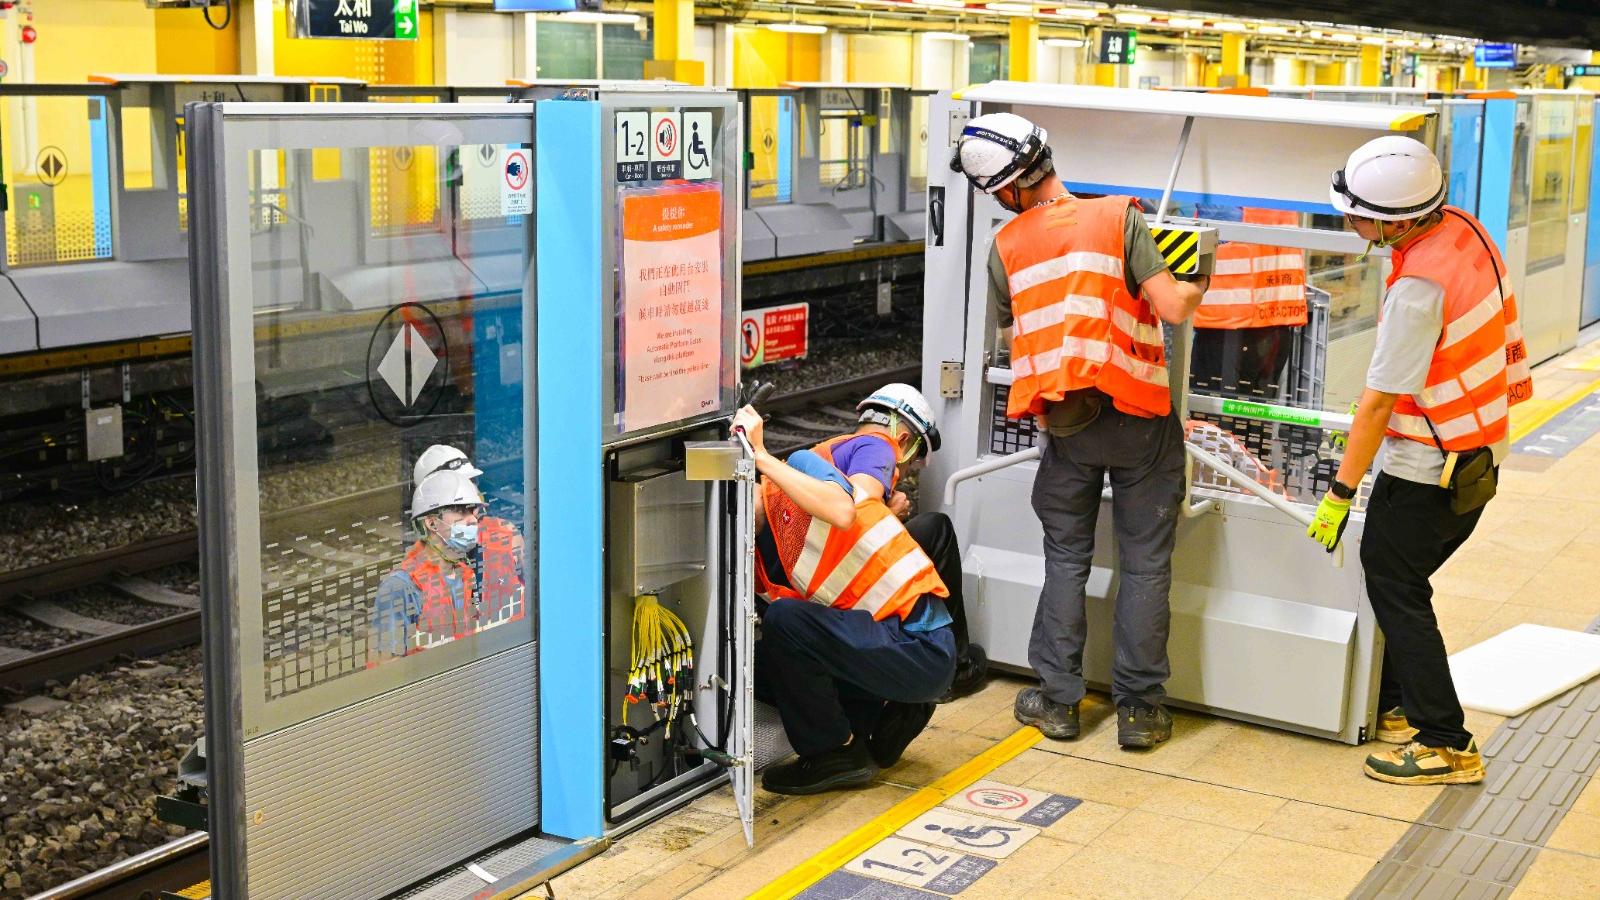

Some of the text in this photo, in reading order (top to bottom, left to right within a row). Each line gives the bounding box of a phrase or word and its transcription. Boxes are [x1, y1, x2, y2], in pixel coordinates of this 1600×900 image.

[339, 20, 368, 33] Tai Wo
[621, 120, 644, 156] 1-2
[863, 848, 949, 877] 1-2
